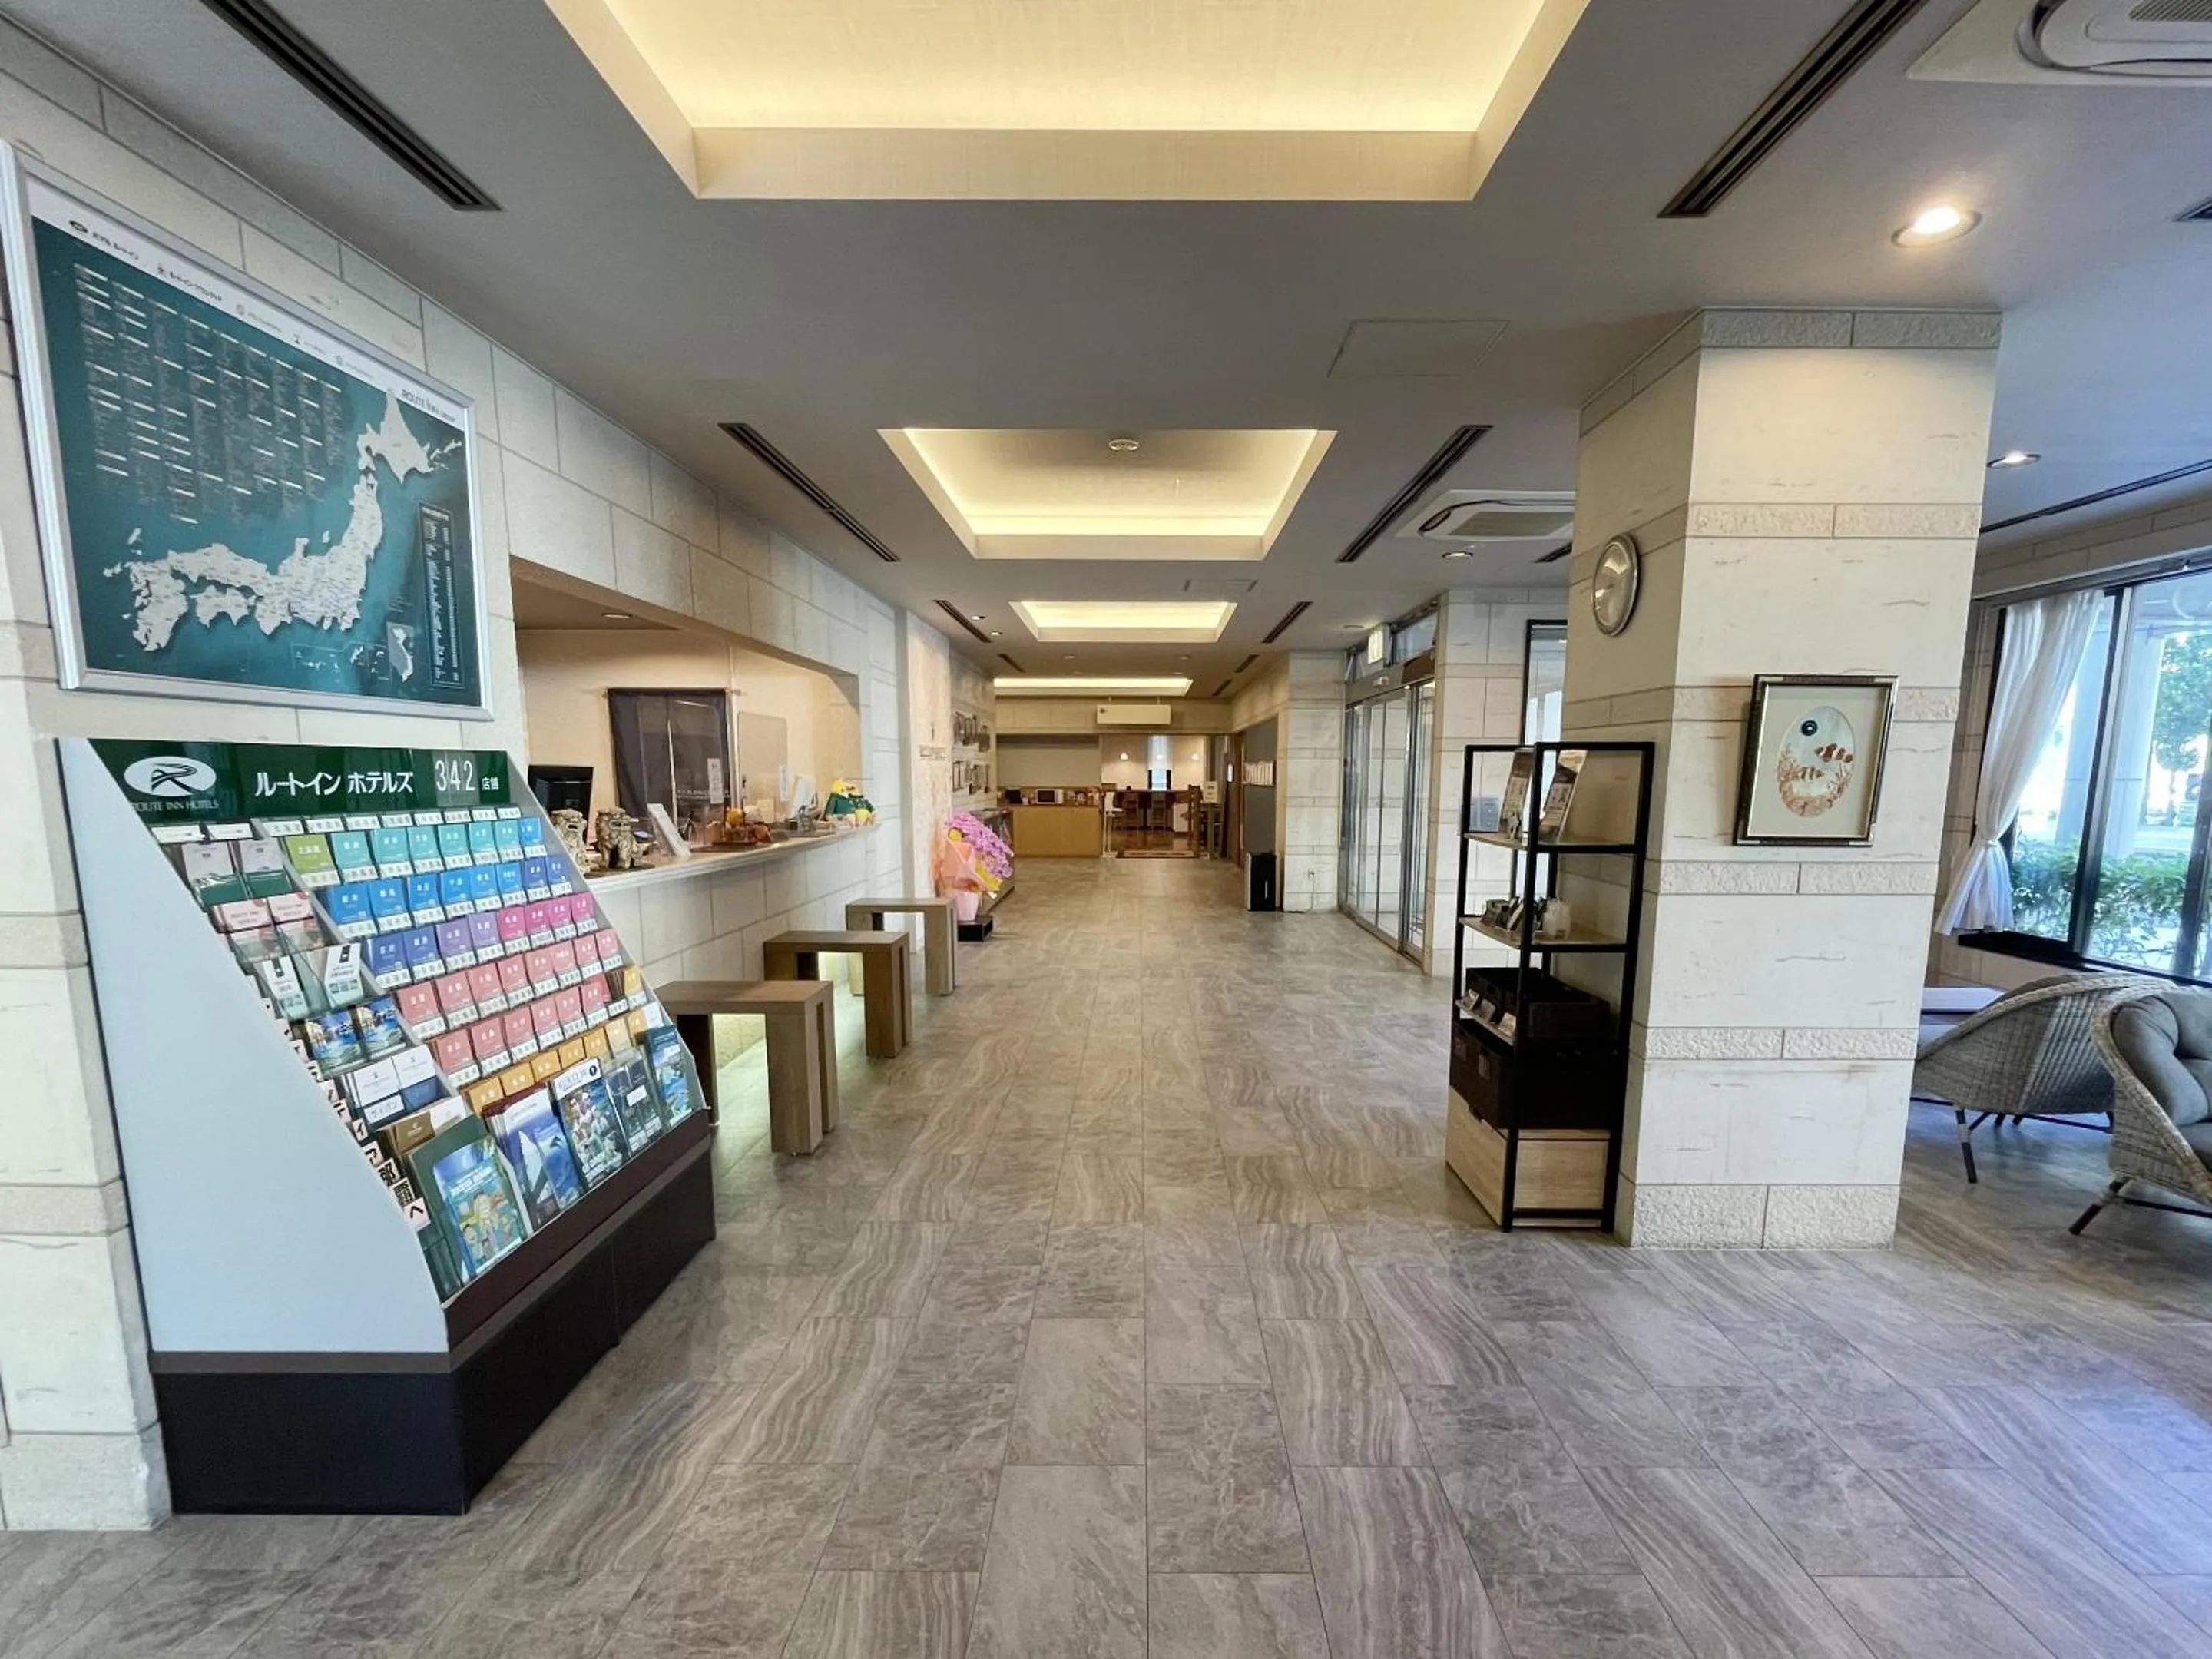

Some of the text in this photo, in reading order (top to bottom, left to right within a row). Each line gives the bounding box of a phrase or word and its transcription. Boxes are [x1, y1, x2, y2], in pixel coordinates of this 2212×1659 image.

[254, 760, 500, 797] ルートイン ホテルズ 342 店舗
[165, 801, 184, 811] INN
[185, 799, 220, 810] HOTELS
